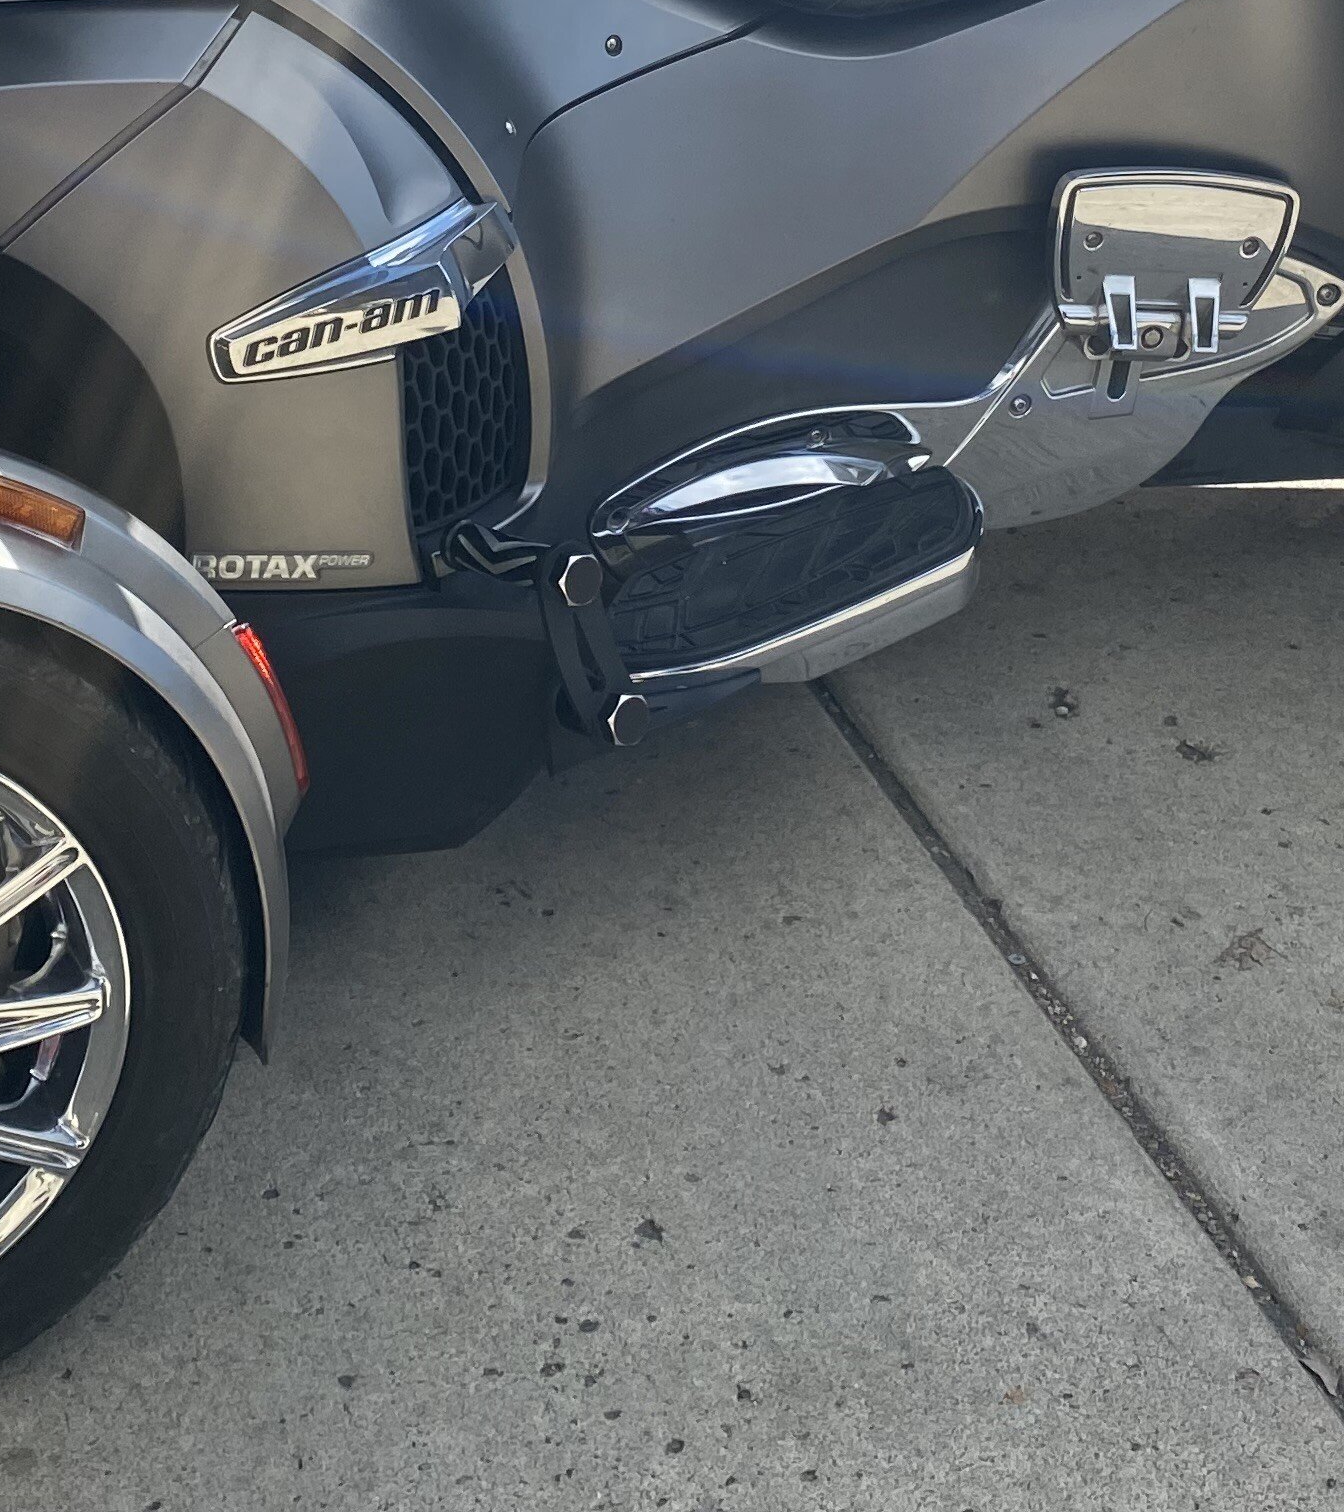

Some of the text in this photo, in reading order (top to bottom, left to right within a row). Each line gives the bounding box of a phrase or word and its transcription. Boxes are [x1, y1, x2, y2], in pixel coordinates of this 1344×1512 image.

[243, 288, 441, 368] can-am
[192, 554, 371, 579] ROTAX POWER
